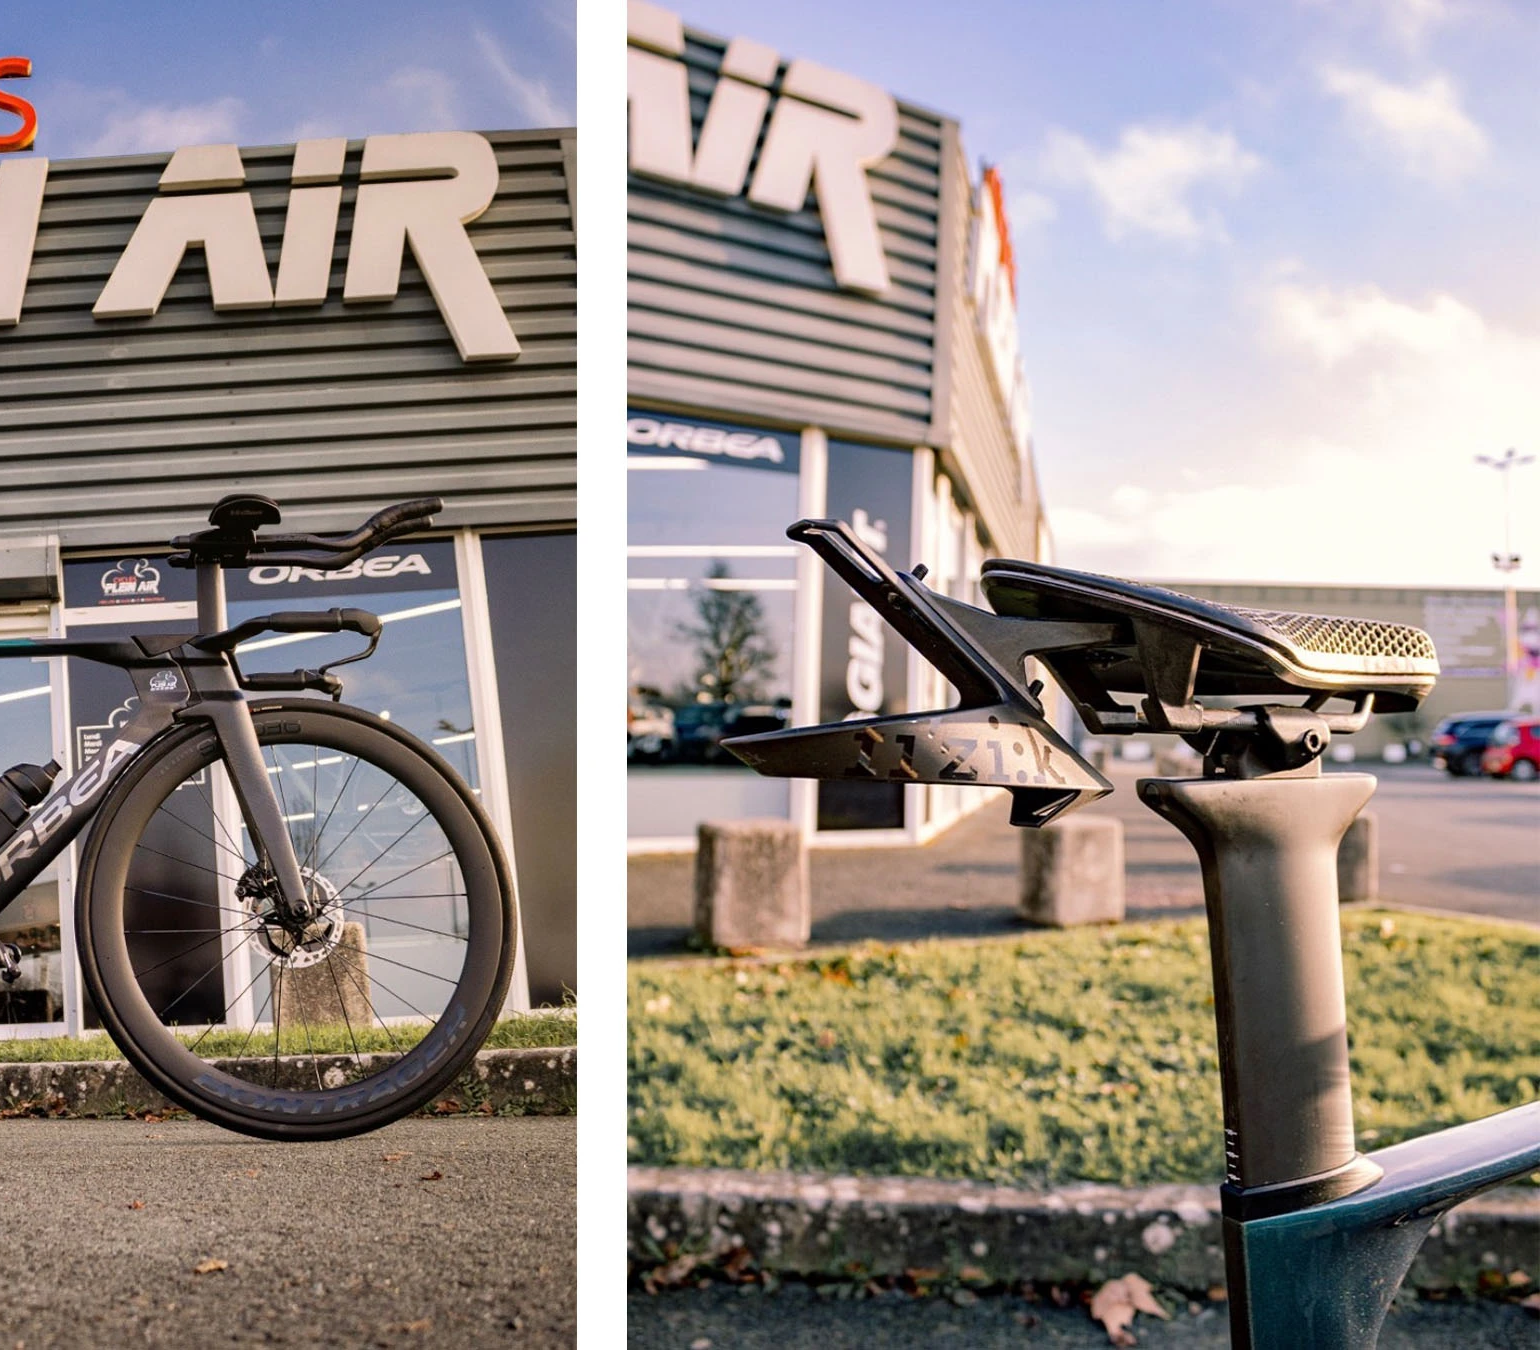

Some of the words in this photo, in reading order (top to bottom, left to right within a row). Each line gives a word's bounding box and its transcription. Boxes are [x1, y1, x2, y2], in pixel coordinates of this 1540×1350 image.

[92, 131, 521, 363] AIR
[627, 418, 785, 464] ORBEA
[248, 553, 432, 585] ORBEA
[846, 508, 888, 713] GIAT
